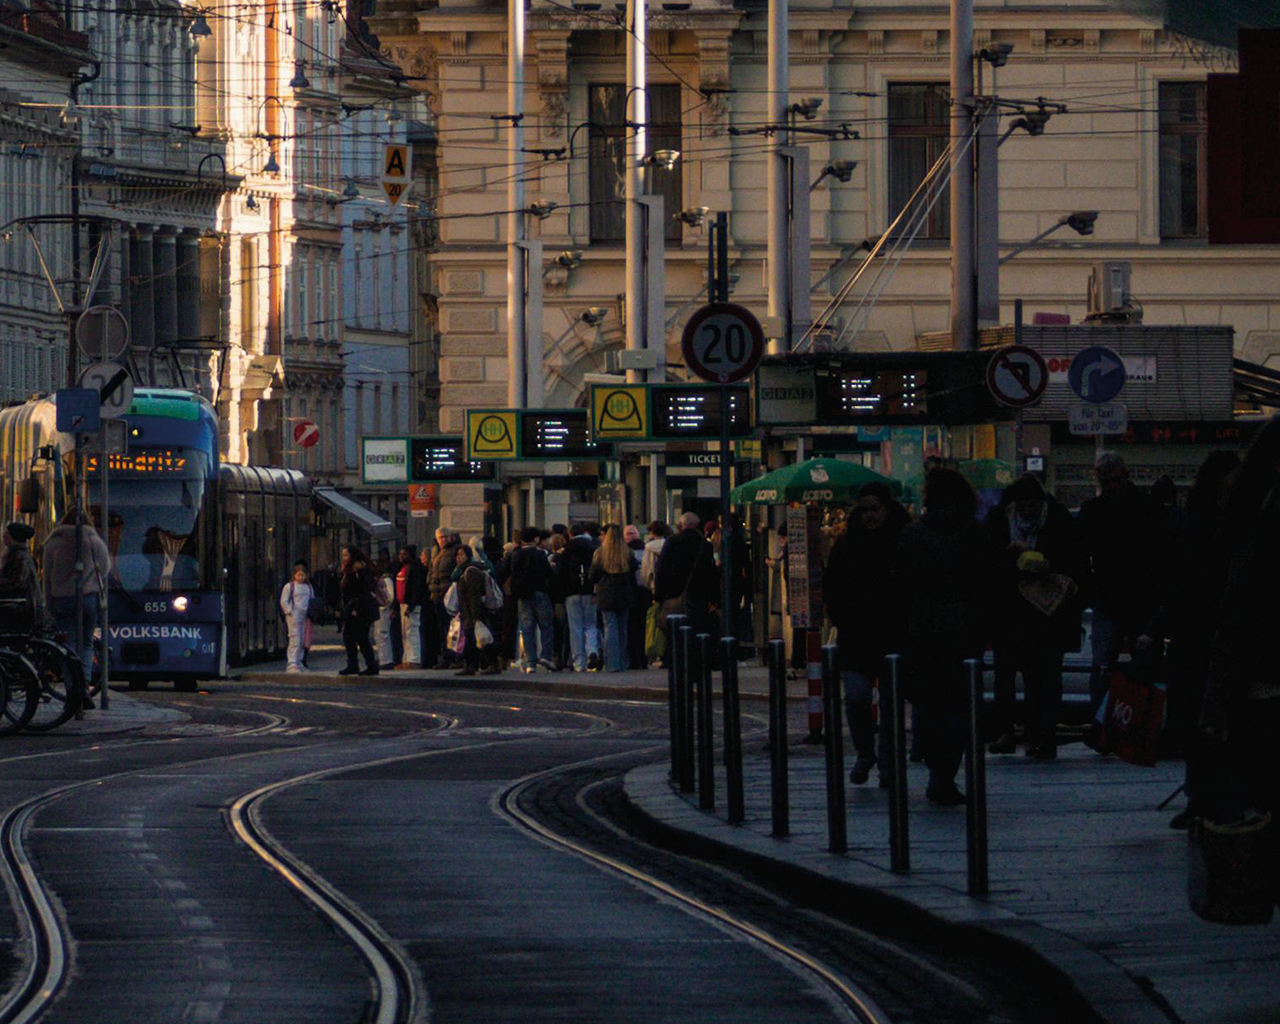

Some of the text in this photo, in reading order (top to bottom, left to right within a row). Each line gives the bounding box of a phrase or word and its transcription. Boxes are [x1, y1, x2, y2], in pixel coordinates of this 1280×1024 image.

[386, 150, 405, 174] A
[389, 183, 402, 196] 20
[703, 324, 745, 364] 20
[802, 489, 833, 501] LOTTO
[144, 601, 167, 613] 655
[109, 626, 202, 639] VOLKSBANK
